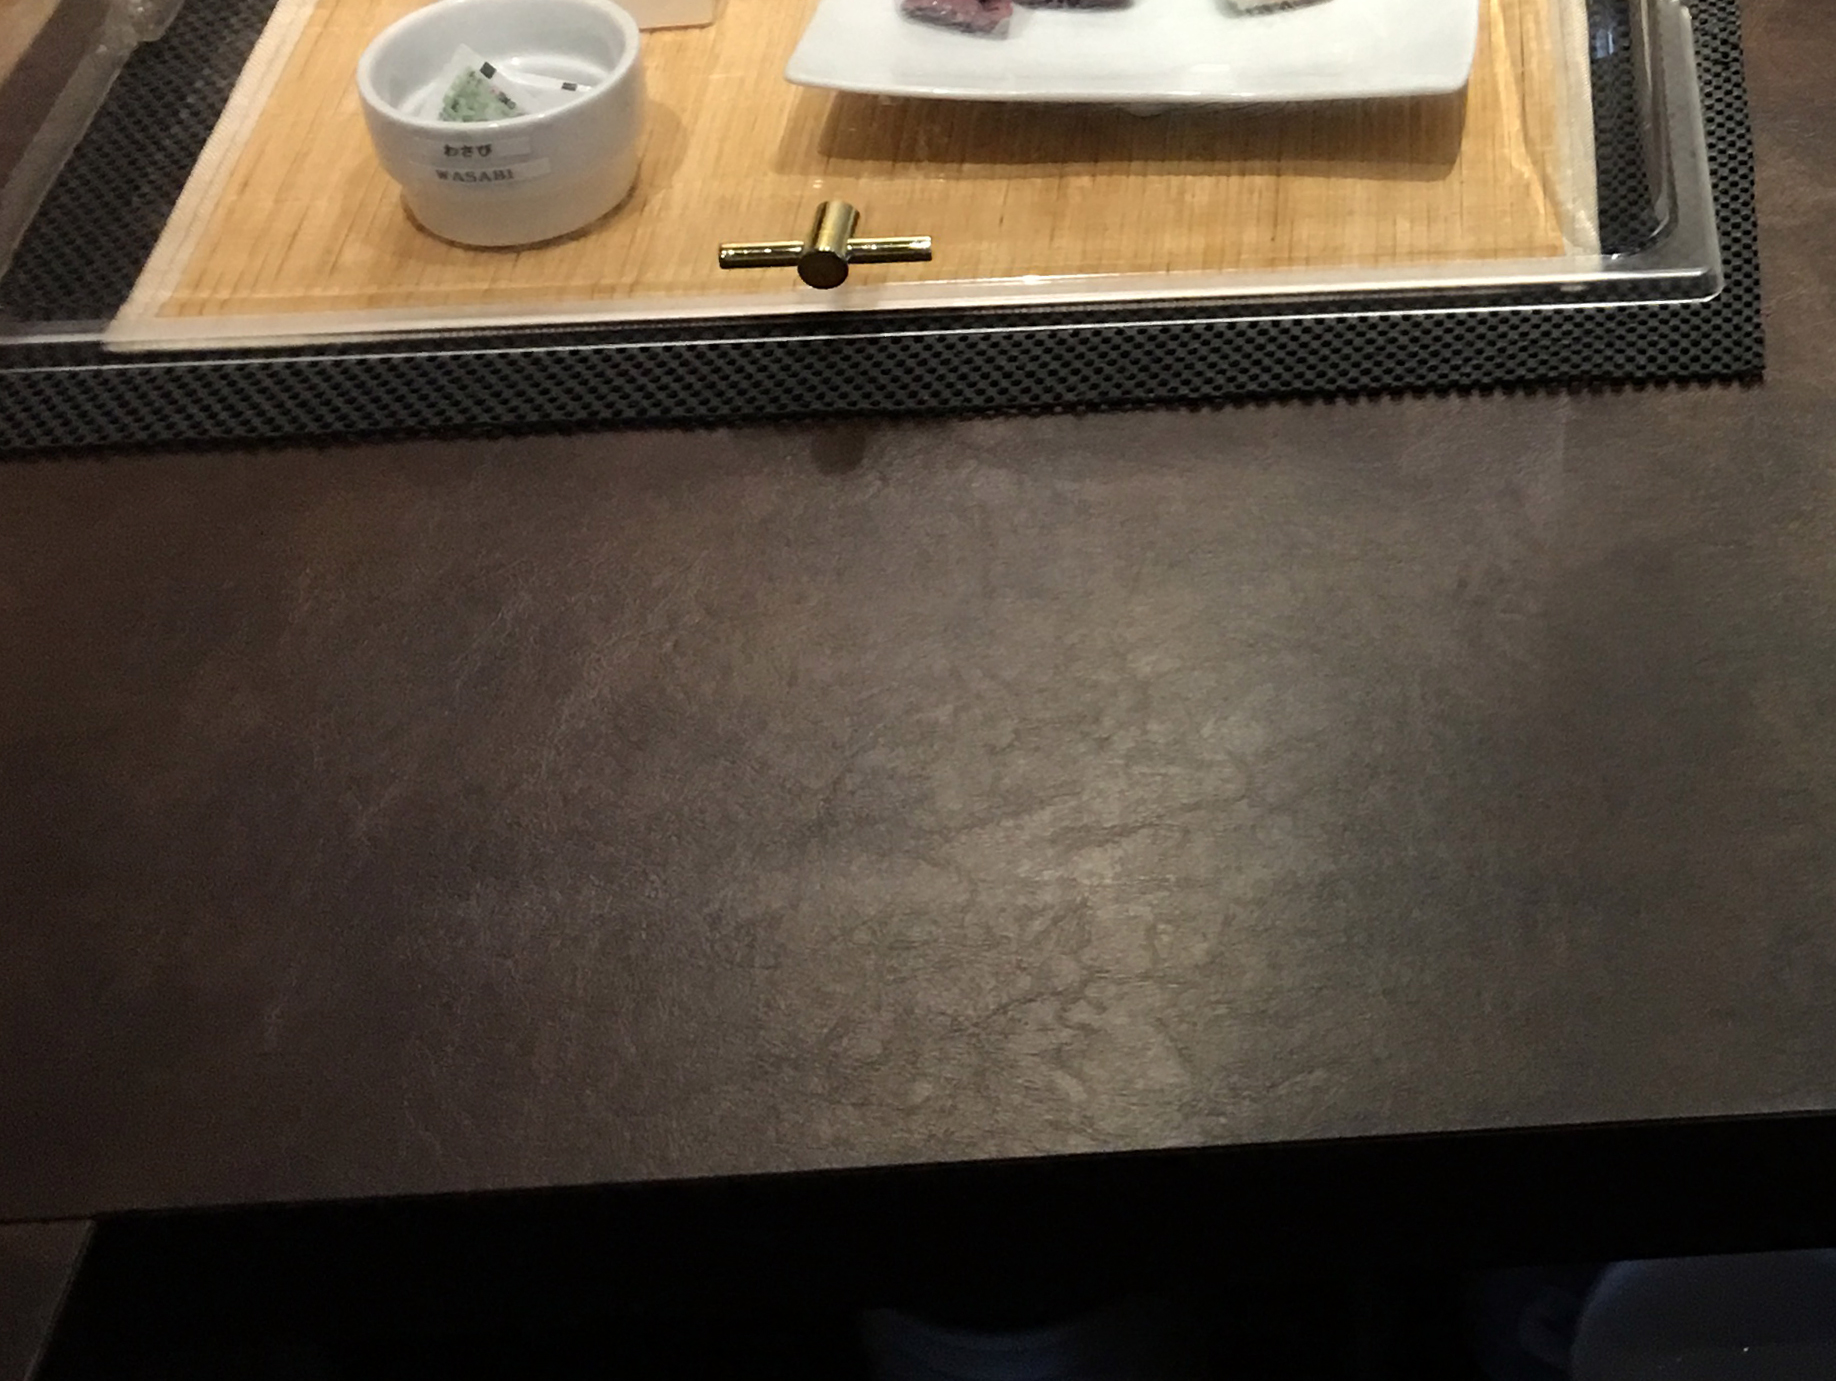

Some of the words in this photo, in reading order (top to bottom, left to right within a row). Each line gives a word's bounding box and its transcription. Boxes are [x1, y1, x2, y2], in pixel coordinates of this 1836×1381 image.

[443, 144, 492, 158] わさび
[436, 168, 515, 183] WASABI
